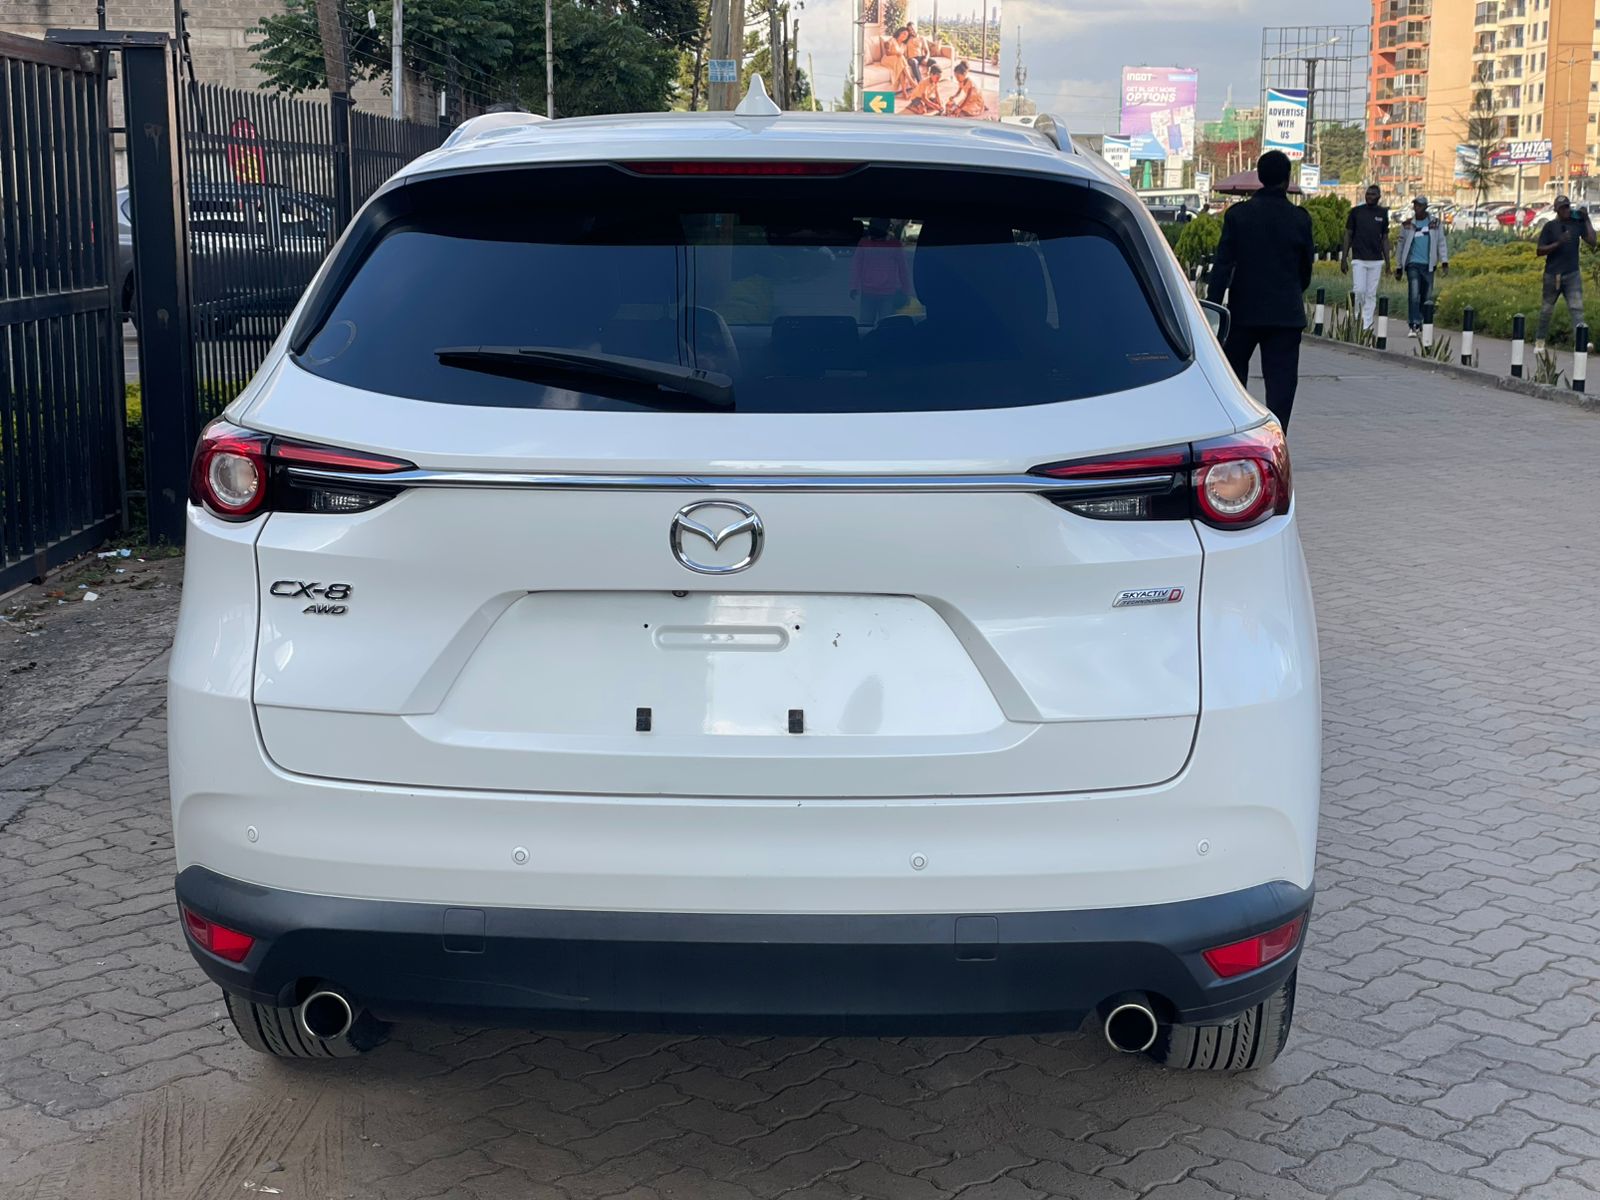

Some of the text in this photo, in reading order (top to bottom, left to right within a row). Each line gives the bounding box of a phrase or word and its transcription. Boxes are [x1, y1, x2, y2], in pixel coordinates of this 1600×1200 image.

[1126, 73, 1153, 81] INGOT
[1126, 92, 1176, 102] OPTIONS
[1268, 107, 1304, 117] ADVERTISE
[1277, 119, 1294, 128] WITH
[1280, 131, 1290, 139] US
[1511, 141, 1545, 153] YAHYA
[270, 580, 353, 600] CX-8
[1122, 590, 1168, 598] SKYACTIV
[302, 604, 348, 615] AWD
